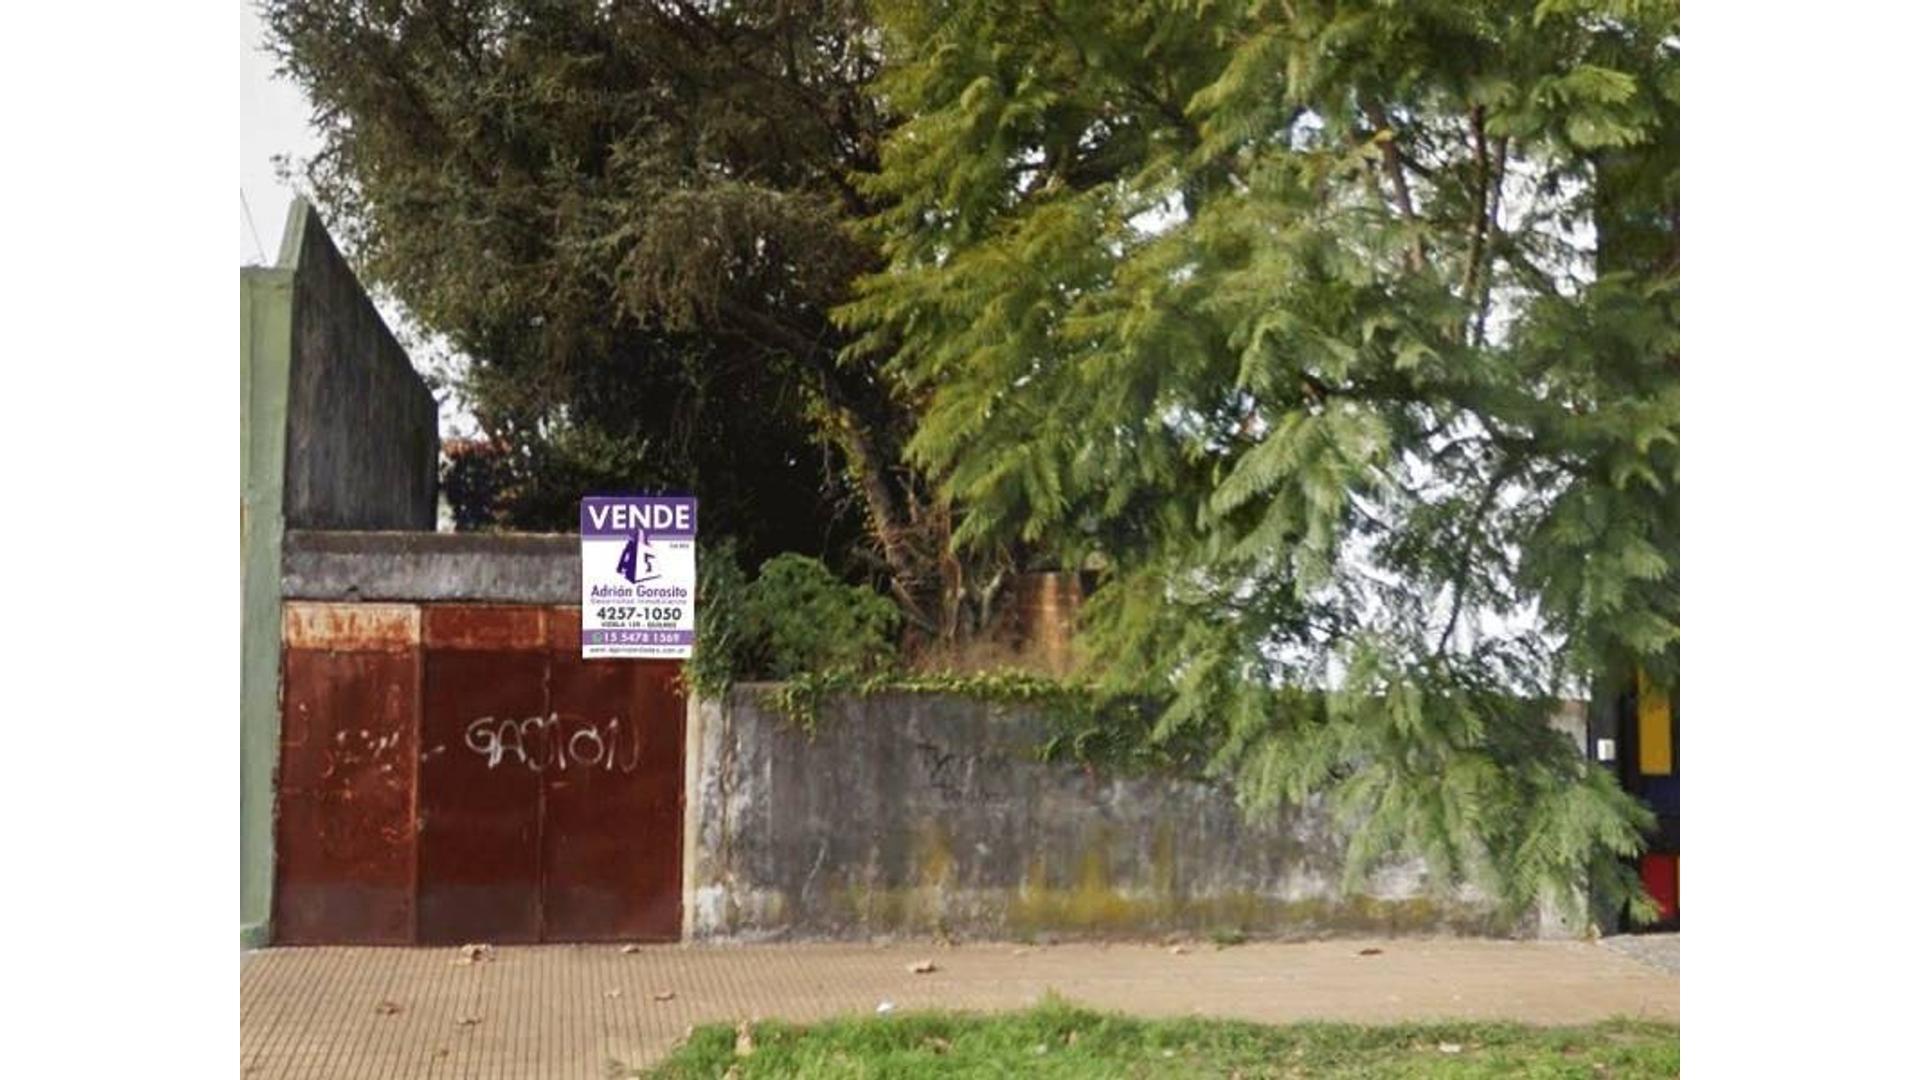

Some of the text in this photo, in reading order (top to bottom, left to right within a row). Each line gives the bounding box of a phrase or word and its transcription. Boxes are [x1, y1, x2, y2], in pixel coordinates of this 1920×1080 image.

[588, 504, 690, 530] VENDE
[591, 585, 688, 598] Adrián Gorosito
[596, 606, 683, 621] 4257-1050
[604, 631, 618, 643] 15
[620, 631, 650, 643] 5478
